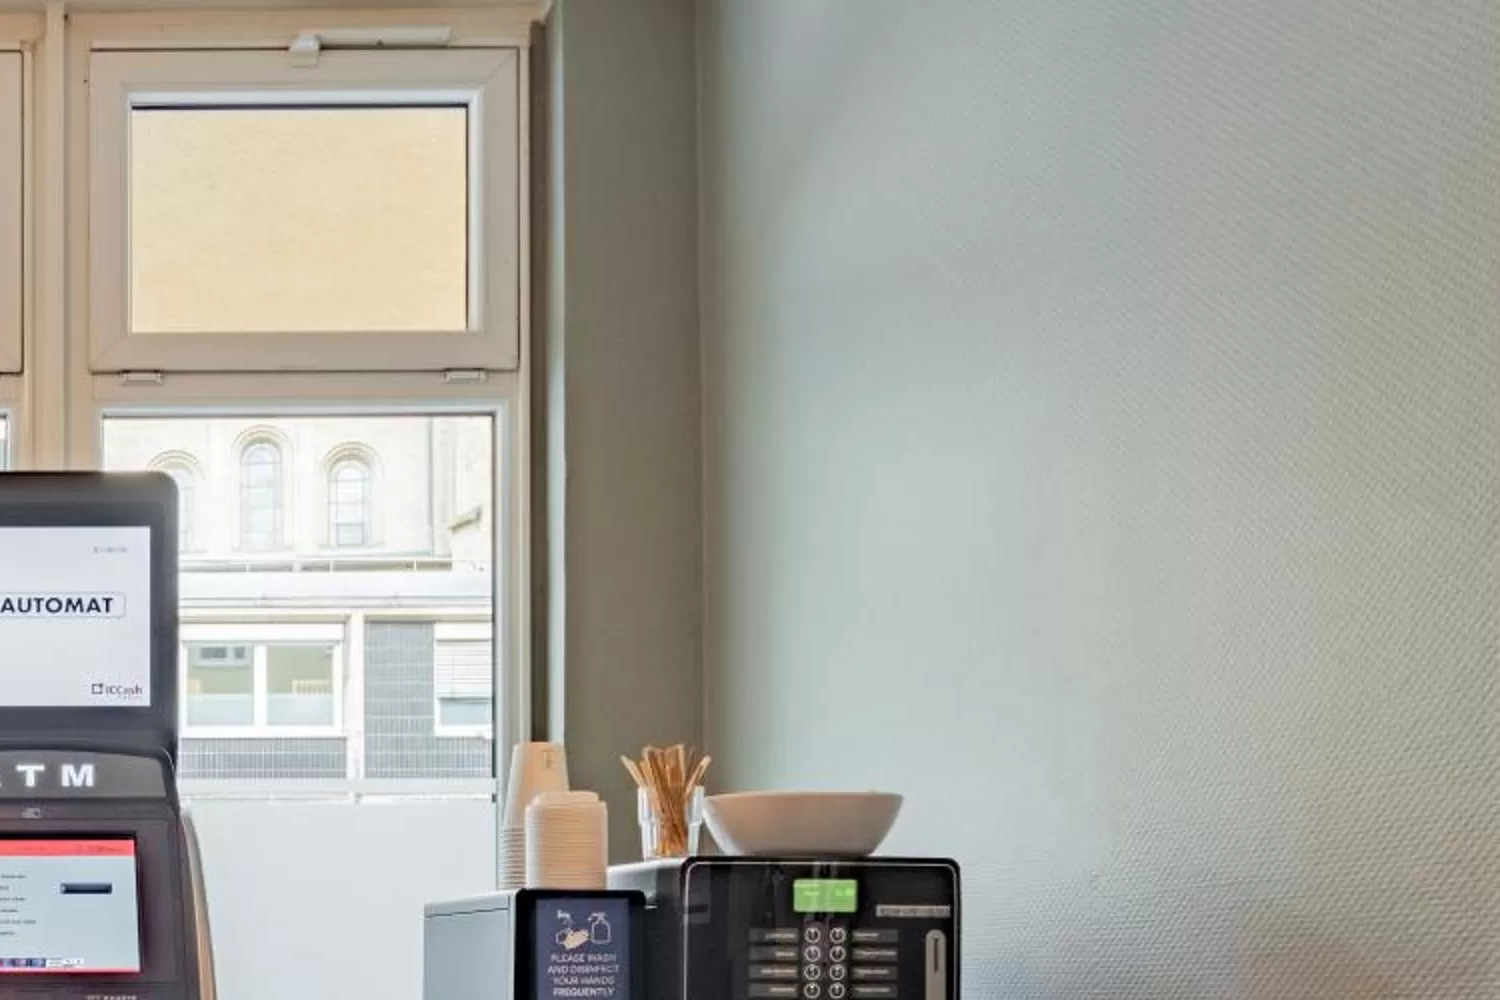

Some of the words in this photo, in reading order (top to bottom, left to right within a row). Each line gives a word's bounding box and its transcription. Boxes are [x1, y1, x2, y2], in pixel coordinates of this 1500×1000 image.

[550, 953, 585, 962] PLEASE
[588, 953, 617, 962] WASH
[547, 965, 569, 974] AND
[570, 965, 620, 974] DISINFECT
[553, 976, 579, 985] YOUR
[581, 976, 615, 985] HANDS
[553, 987, 615, 997] FREQUENTLY
